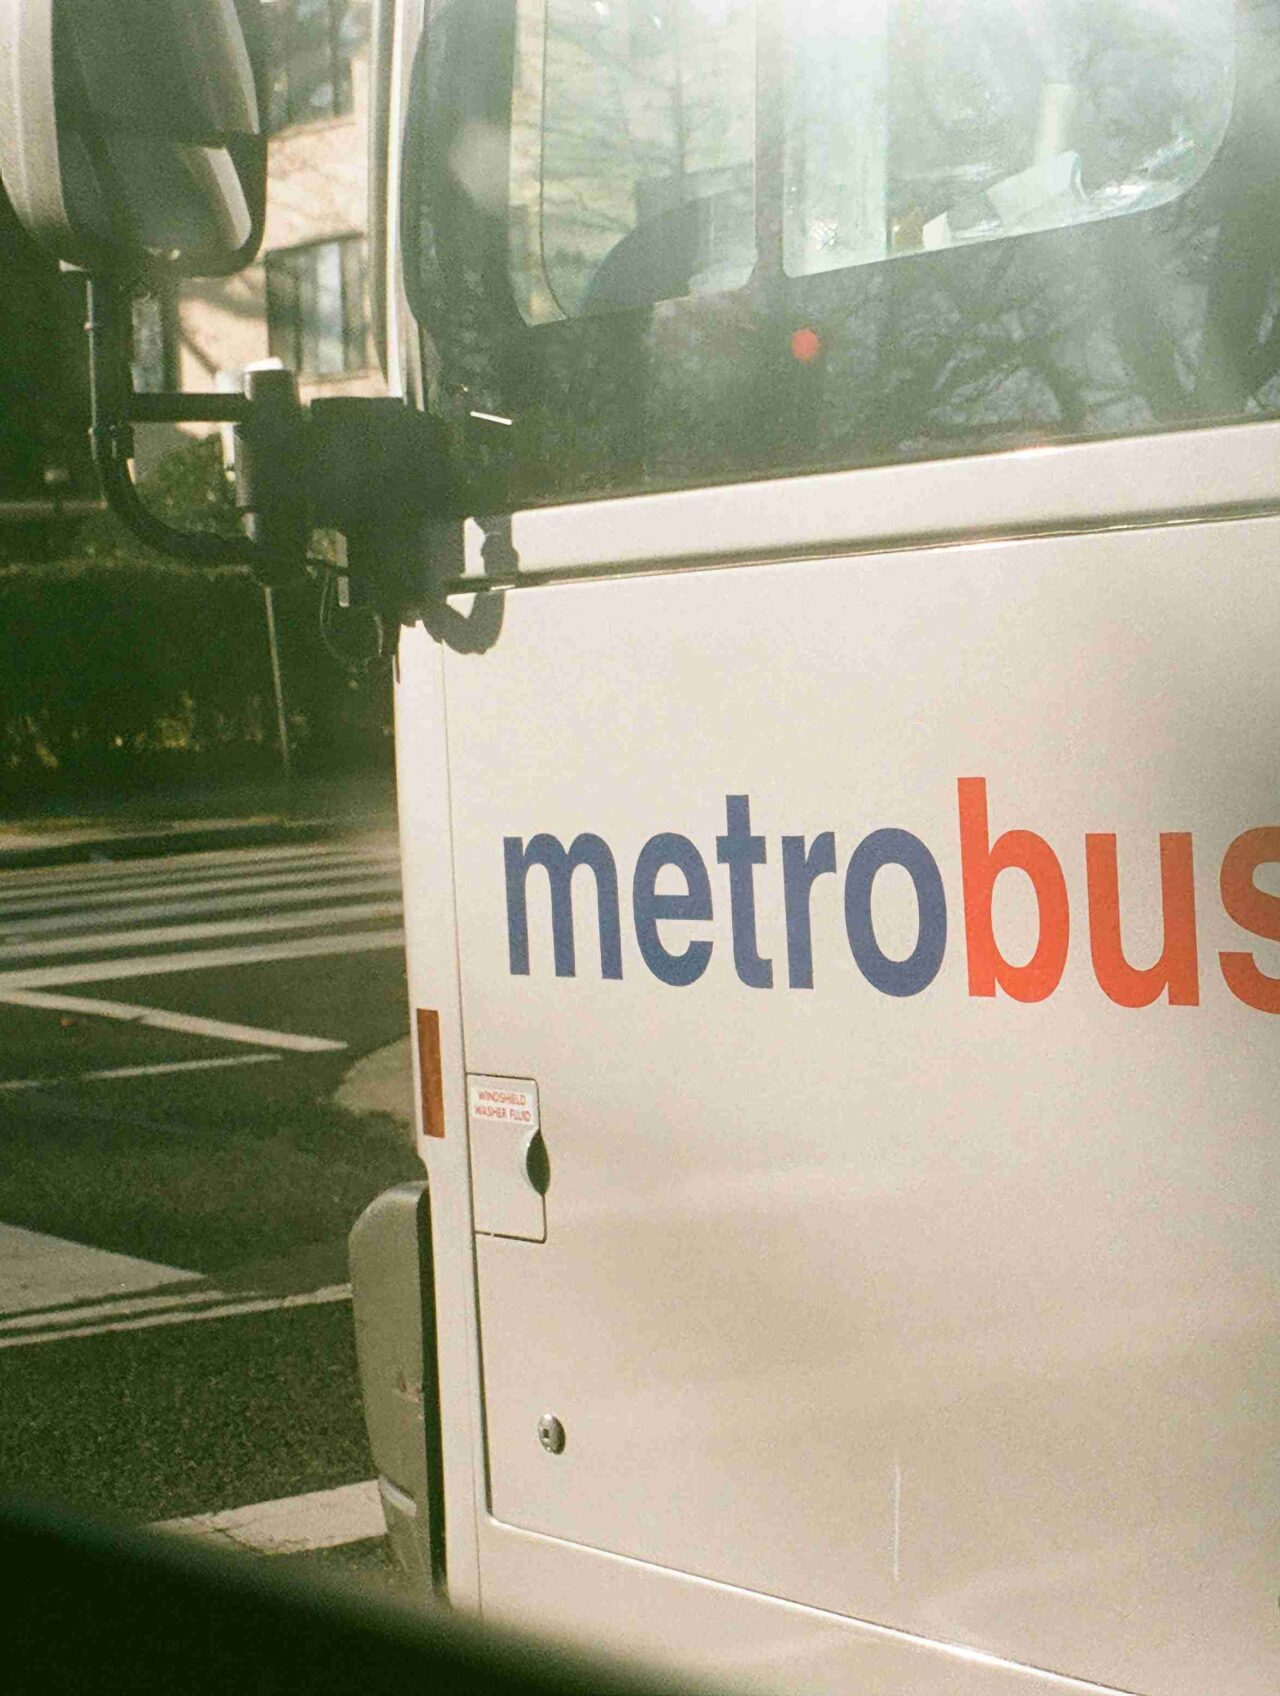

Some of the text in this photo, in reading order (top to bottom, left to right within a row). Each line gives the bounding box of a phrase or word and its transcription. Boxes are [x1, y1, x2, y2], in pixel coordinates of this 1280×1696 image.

[478, 1090, 526, 1105] WINDSHIELD
[474, 1105, 531, 1122] WASHER FLUID
